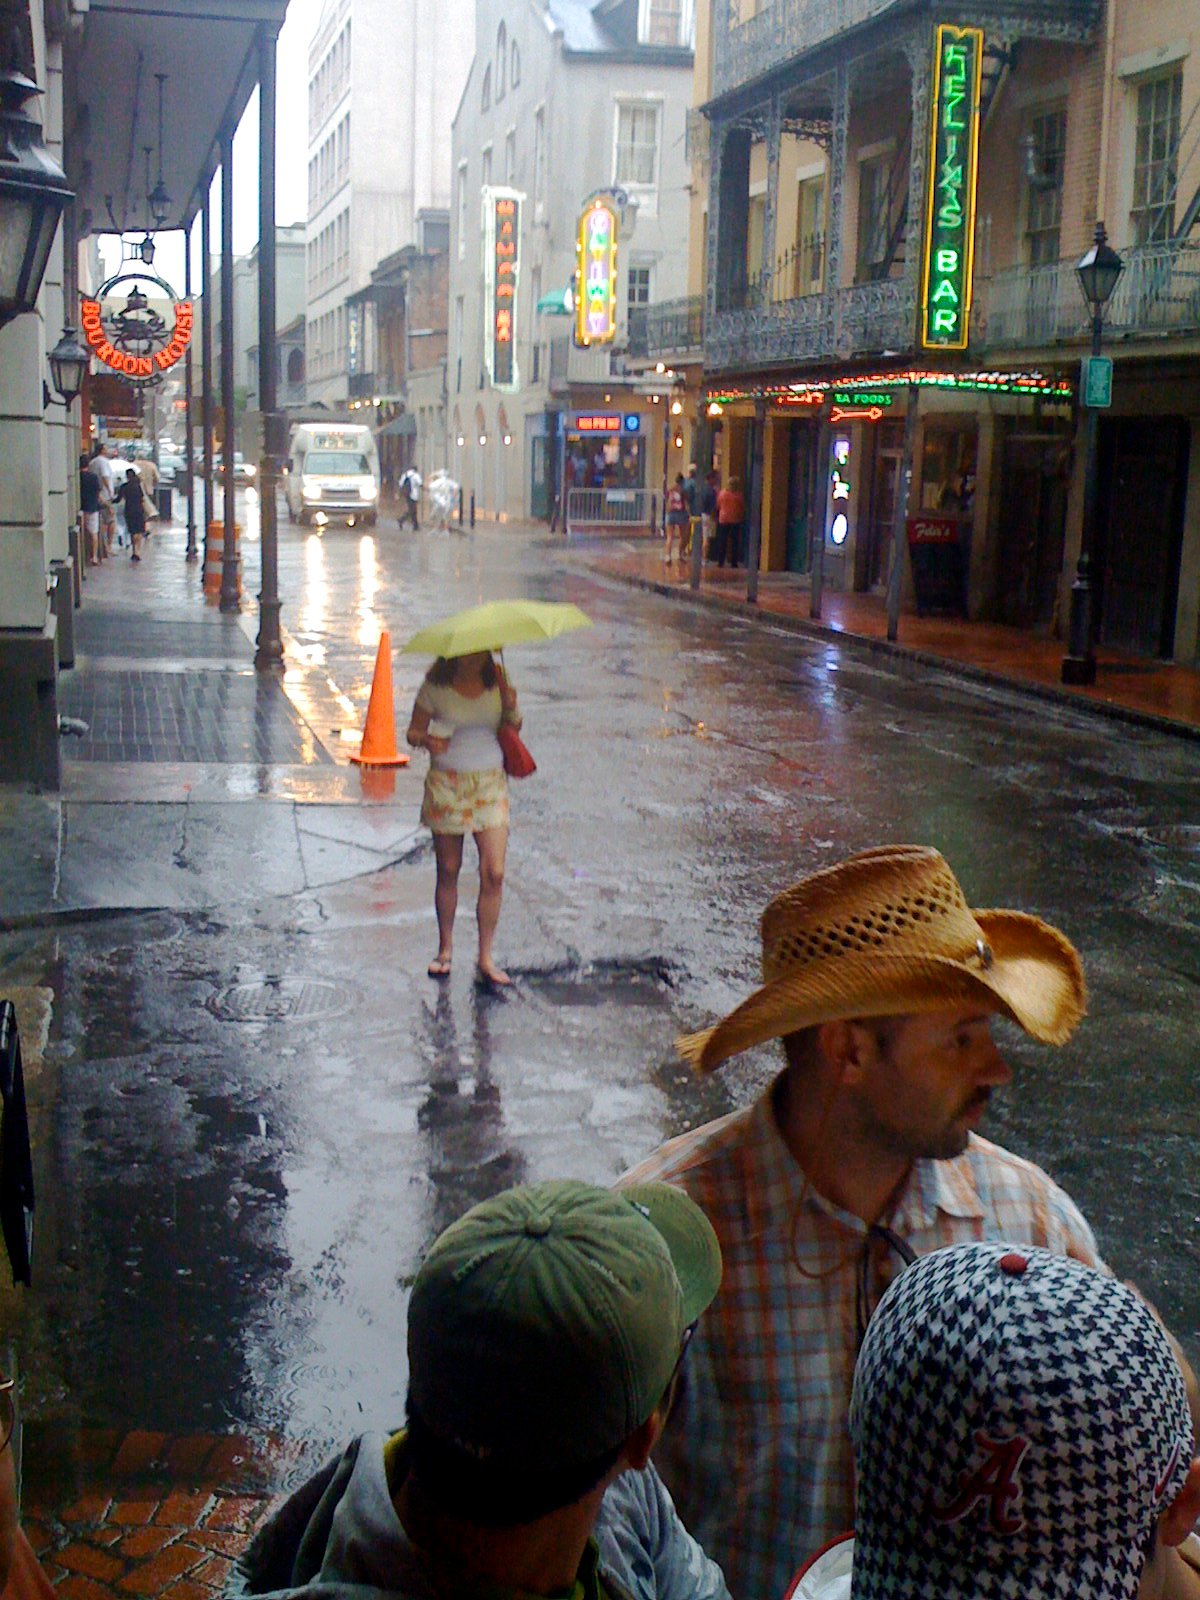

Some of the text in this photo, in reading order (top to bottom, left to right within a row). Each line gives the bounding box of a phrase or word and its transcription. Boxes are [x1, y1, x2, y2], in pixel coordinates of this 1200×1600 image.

[931, 249, 958, 333] BAR
[81, 300, 194, 376] BOURBON HOUSE
[853, 393, 893, 406] FOODS
[928, 1430, 1031, 1536] A
